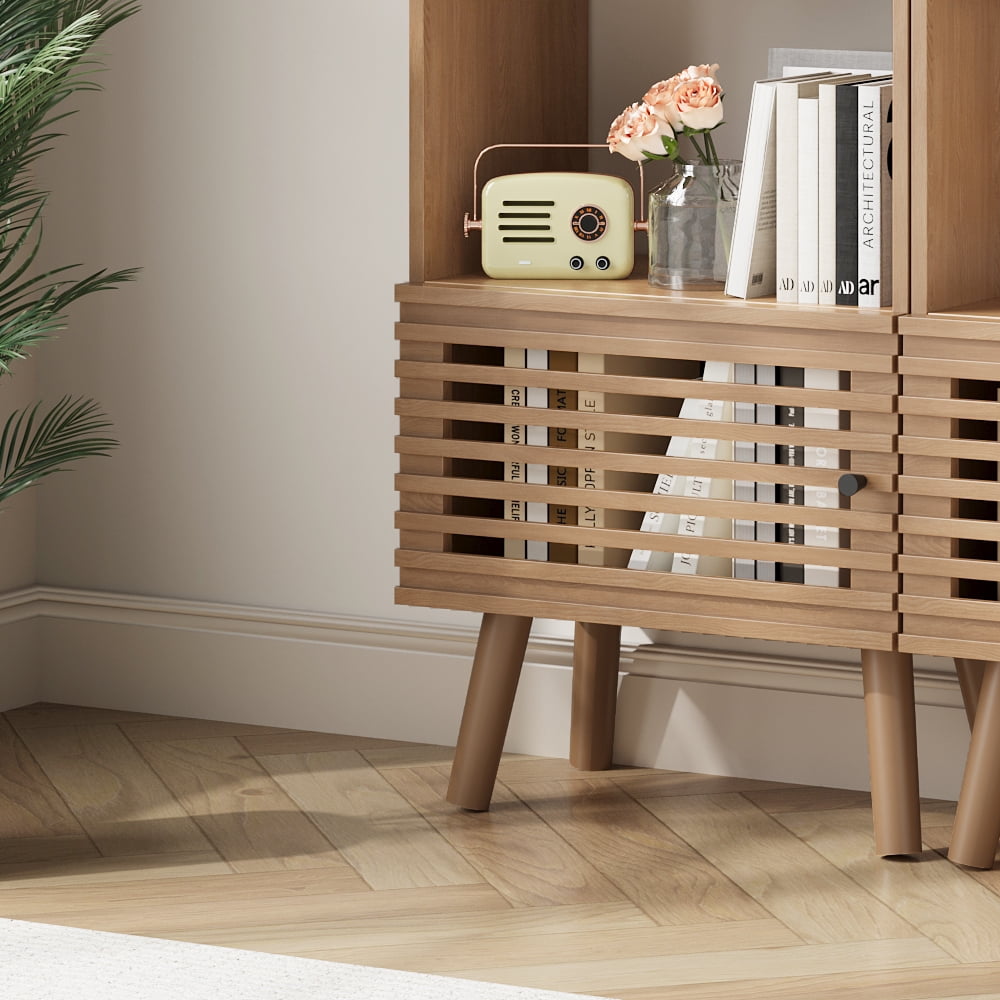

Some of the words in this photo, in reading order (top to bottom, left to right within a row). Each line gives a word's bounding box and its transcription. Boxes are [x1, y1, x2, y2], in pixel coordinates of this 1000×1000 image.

[862, 100, 874, 249] ARCHITECTURAL
[779, 277, 794, 291] AD
[800, 280, 815, 293] AD
[820, 280, 833, 293] AD
[838, 280, 855, 295] AD
[859, 278, 880, 296] ar
